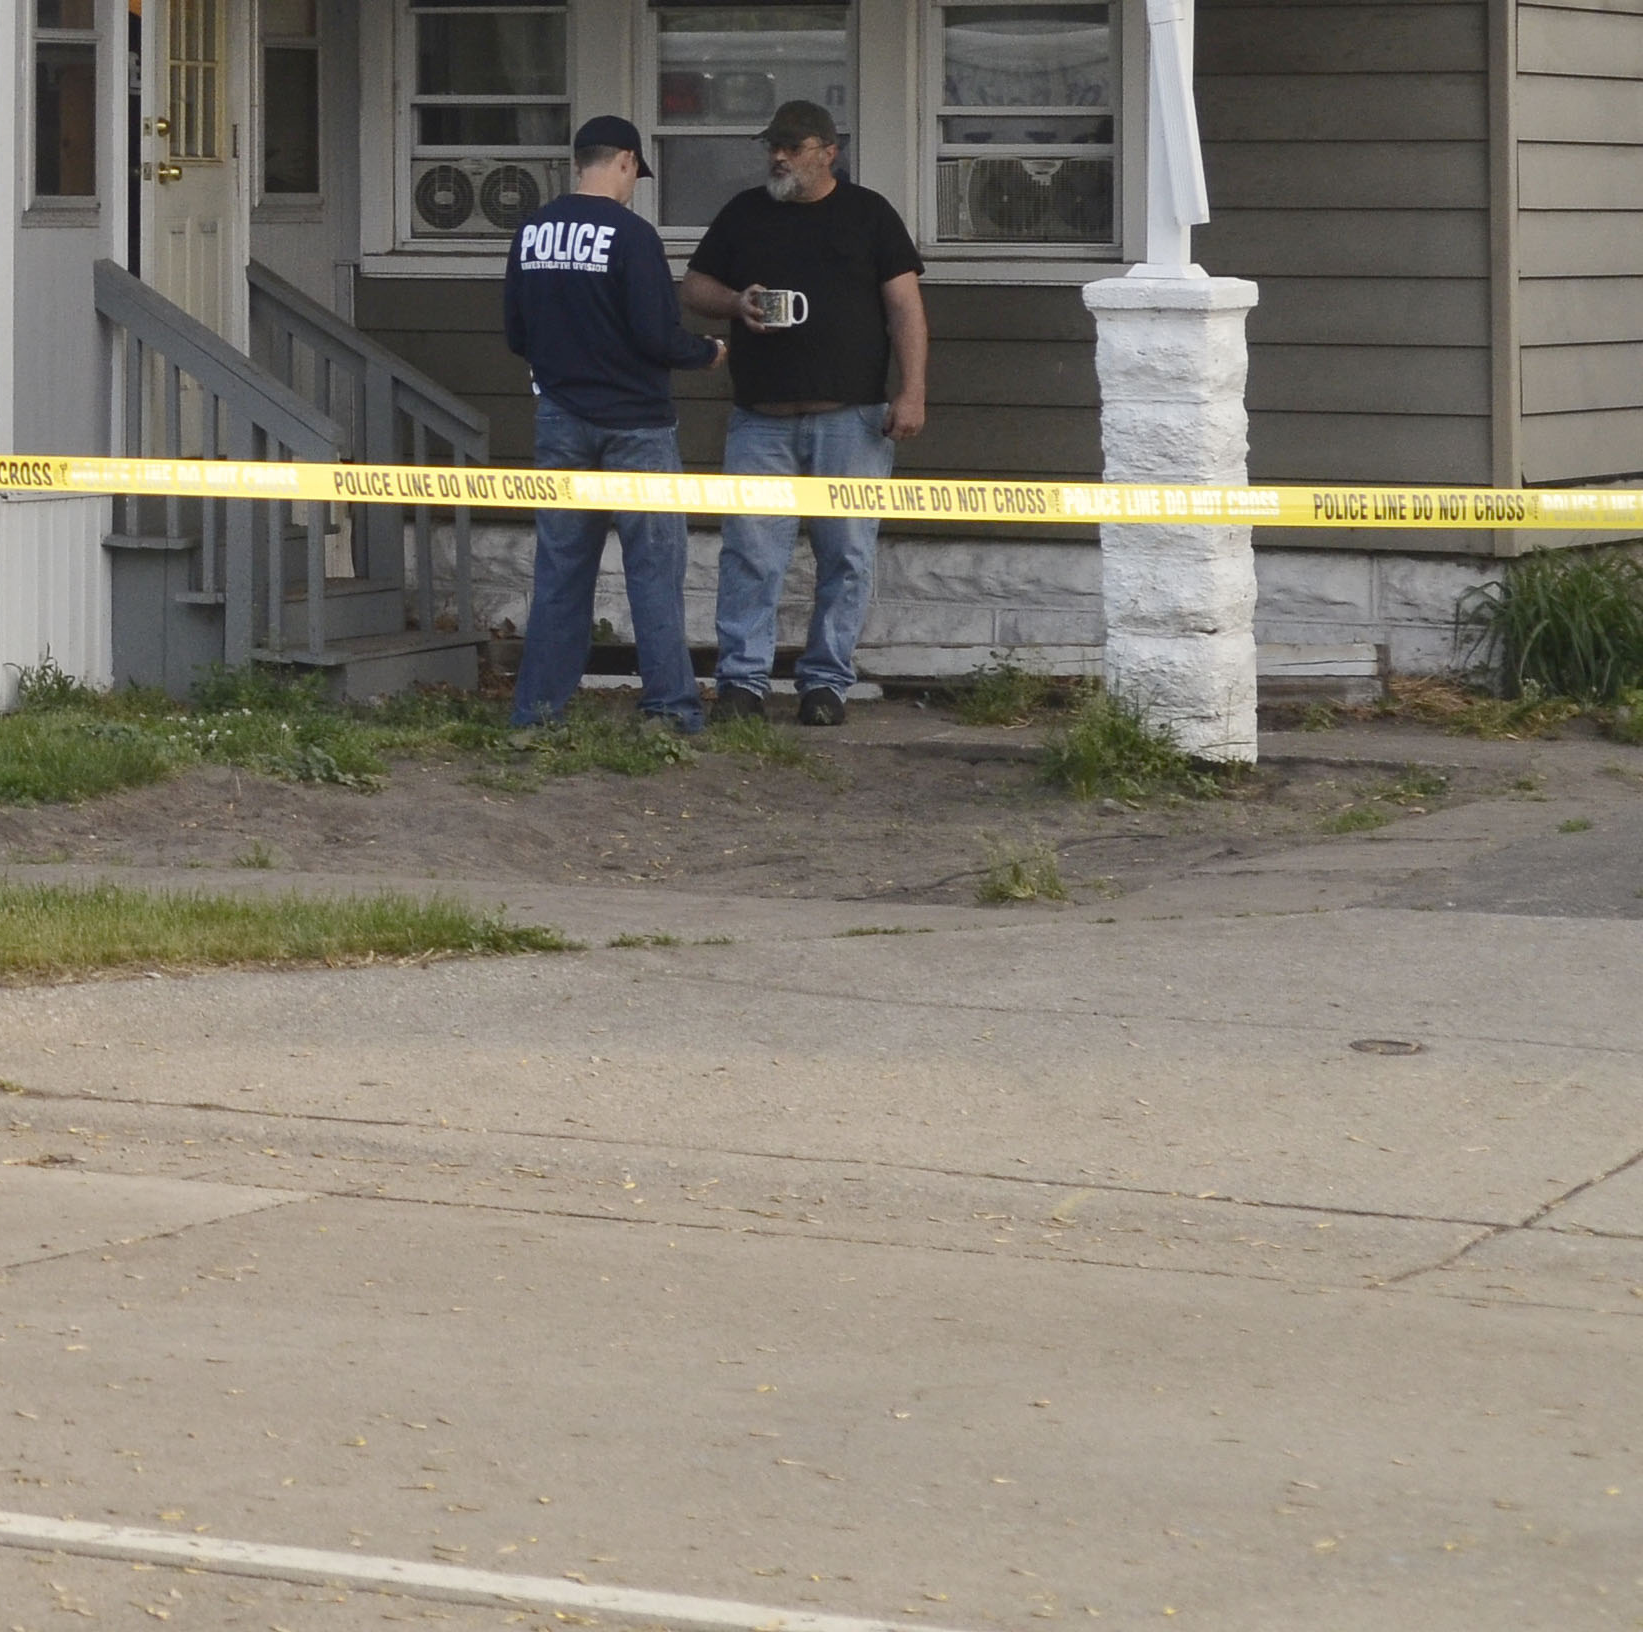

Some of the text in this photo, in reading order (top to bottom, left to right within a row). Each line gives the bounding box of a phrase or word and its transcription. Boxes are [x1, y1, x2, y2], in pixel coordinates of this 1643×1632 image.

[520, 221, 616, 264] POLICE
[334, 471, 394, 497] POLICE
[397, 473, 435, 498] LINE
[437, 474, 461, 498] DO
[465, 474, 497, 499] NOT
[502, 475, 557, 501] CROSS
[573, 475, 635, 504] POLICE
[636, 476, 675, 505] LINE
[677, 477, 701, 506] DO
[704, 478, 737, 507] NOT
[739, 478, 796, 508] CROSS
[828, 484, 886, 511] POLICE
[890, 485, 926, 511] LINE
[929, 486, 951, 512] DO
[956, 486, 987, 513] NOT
[993, 487, 1046, 514] CROSS
[1065, 487, 1122, 515] POLICE
[1124, 488, 1161, 515] LINE
[1165, 489, 1187, 516] DO
[1191, 490, 1221, 516] NOT
[1226, 490, 1280, 517] CROSS
[1314, 493, 1367, 520] POLICE
[1373, 494, 1407, 520] LINE
[1413, 494, 1433, 520] DO
[1439, 494, 1467, 521] NOT
[1474, 494, 1525, 521] CROSS
